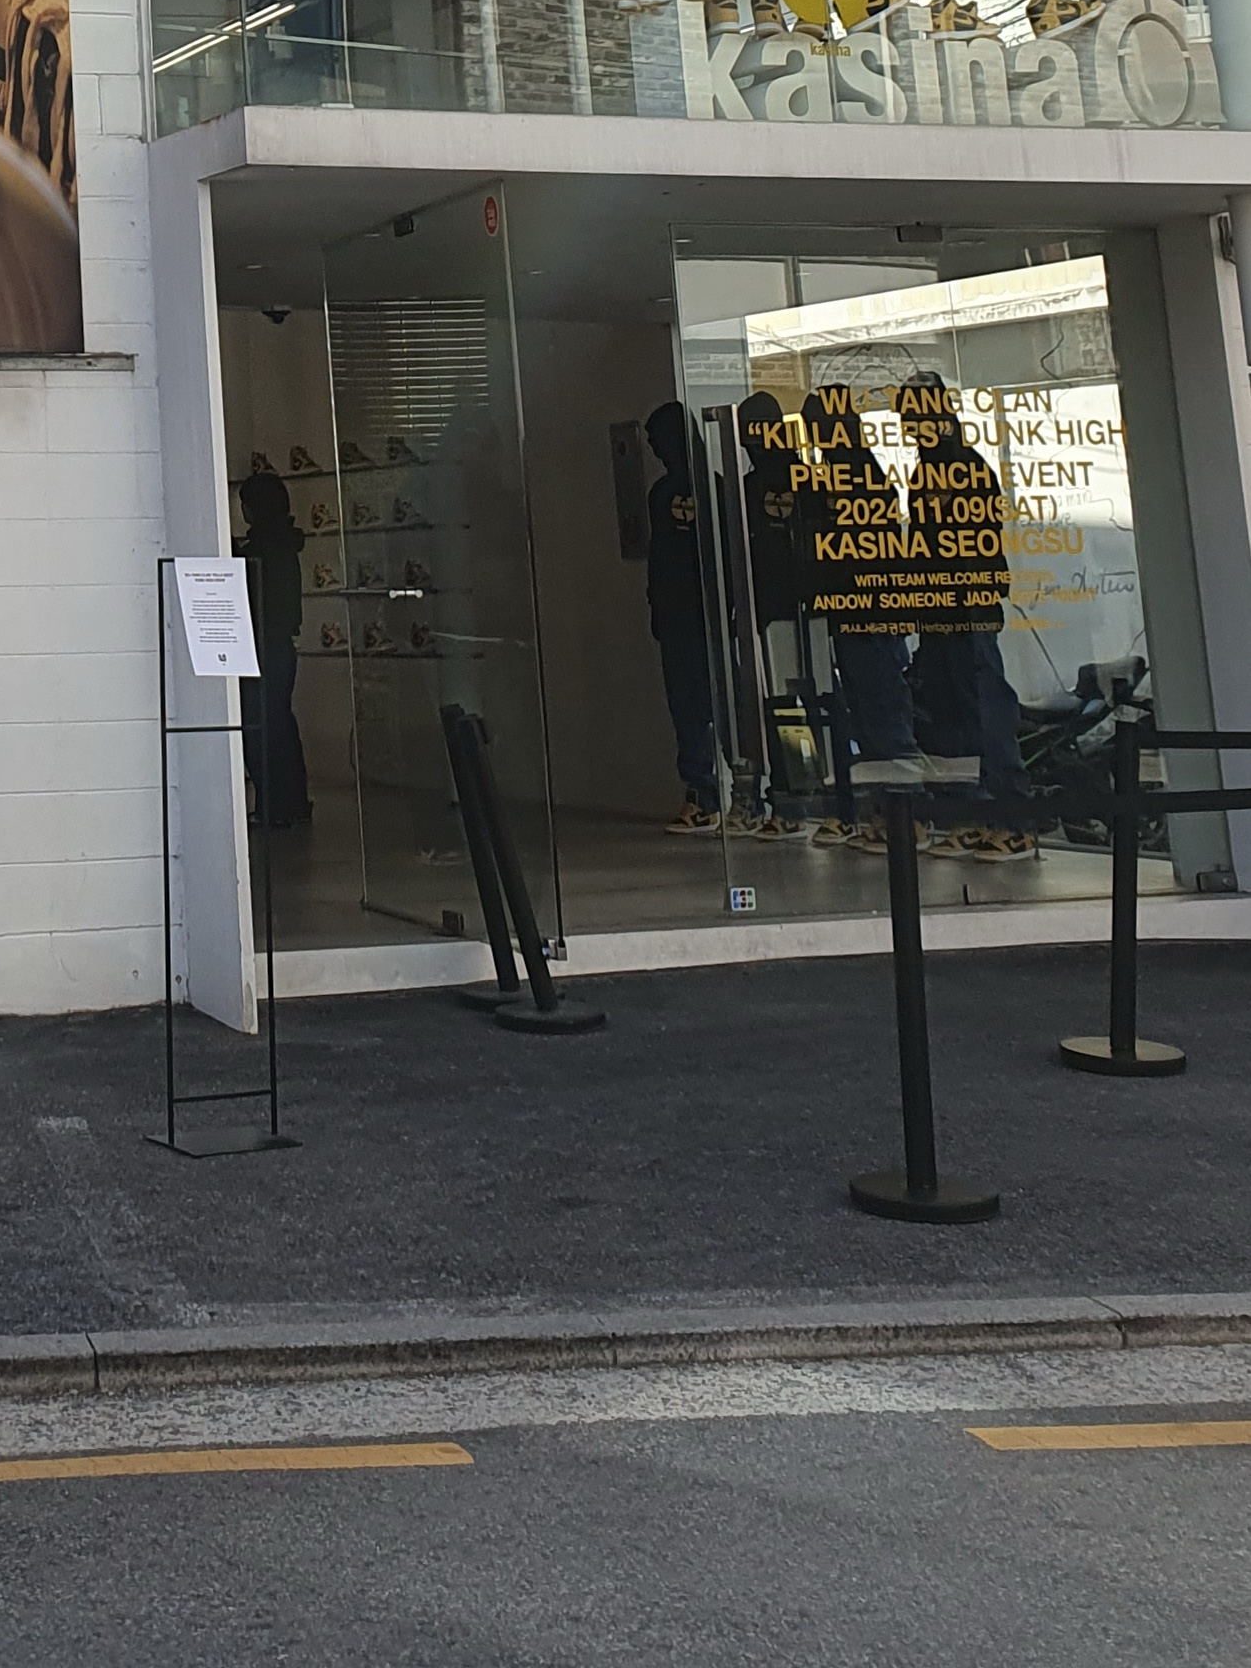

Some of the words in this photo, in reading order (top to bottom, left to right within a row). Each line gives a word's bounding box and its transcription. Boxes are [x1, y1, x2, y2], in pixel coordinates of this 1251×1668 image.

[974, 389, 1052, 415] CLAN
[961, 419, 1046, 448] DUNK
[1056, 418, 1128, 445] HIGH
[789, 462, 991, 492] PRE-LAUNCH
[1000, 461, 1094, 488] EVENT
[836, 495, 1058, 526] 2024.11.09(SAT)
[815, 531, 931, 561] KASINA
[937, 526, 1085, 559] SEONGSU
[854, 574, 888, 588] WITH
[889, 573, 926, 586] TEAM
[927, 571, 992, 585] WELCOME
[813, 593, 873, 611] ANDOW
[879, 591, 958, 609] SOMEONE
[962, 590, 1003, 607] JADA
